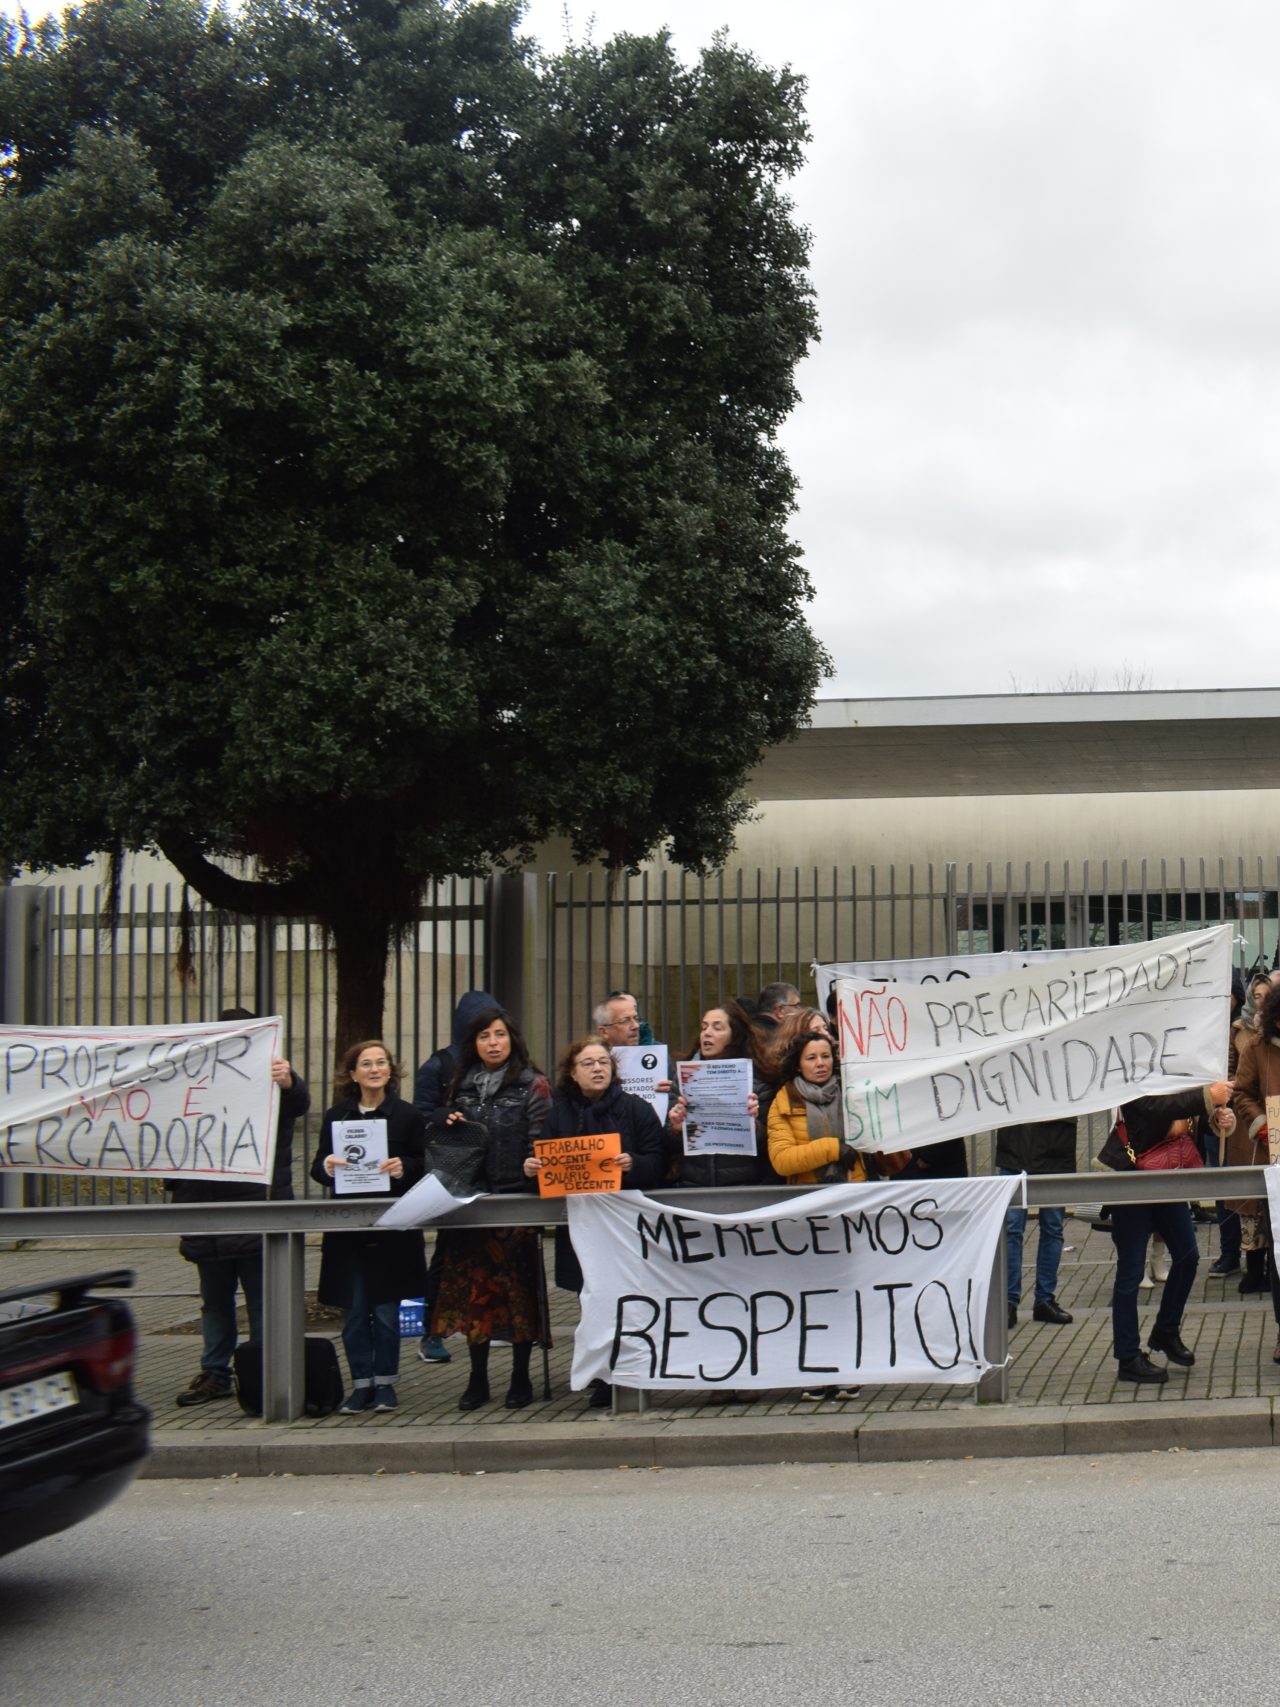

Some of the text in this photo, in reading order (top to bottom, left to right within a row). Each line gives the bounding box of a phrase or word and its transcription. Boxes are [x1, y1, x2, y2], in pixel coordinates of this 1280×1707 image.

[838, 940, 1214, 1058] NÃO PRECARIEDADE
[6, 1035, 252, 1095] PROFESSOR
[845, 1026, 1194, 1142] SIM DIGNIDADE
[183, 1075, 209, 1117] É
[0, 1105, 262, 1173] ERCADORIA
[536, 1138, 605, 1155] TRABALHO
[540, 1153, 592, 1168] DOCENTE
[564, 1180, 616, 1191] DECENTE
[637, 1198, 944, 1263] MERECEMOS
